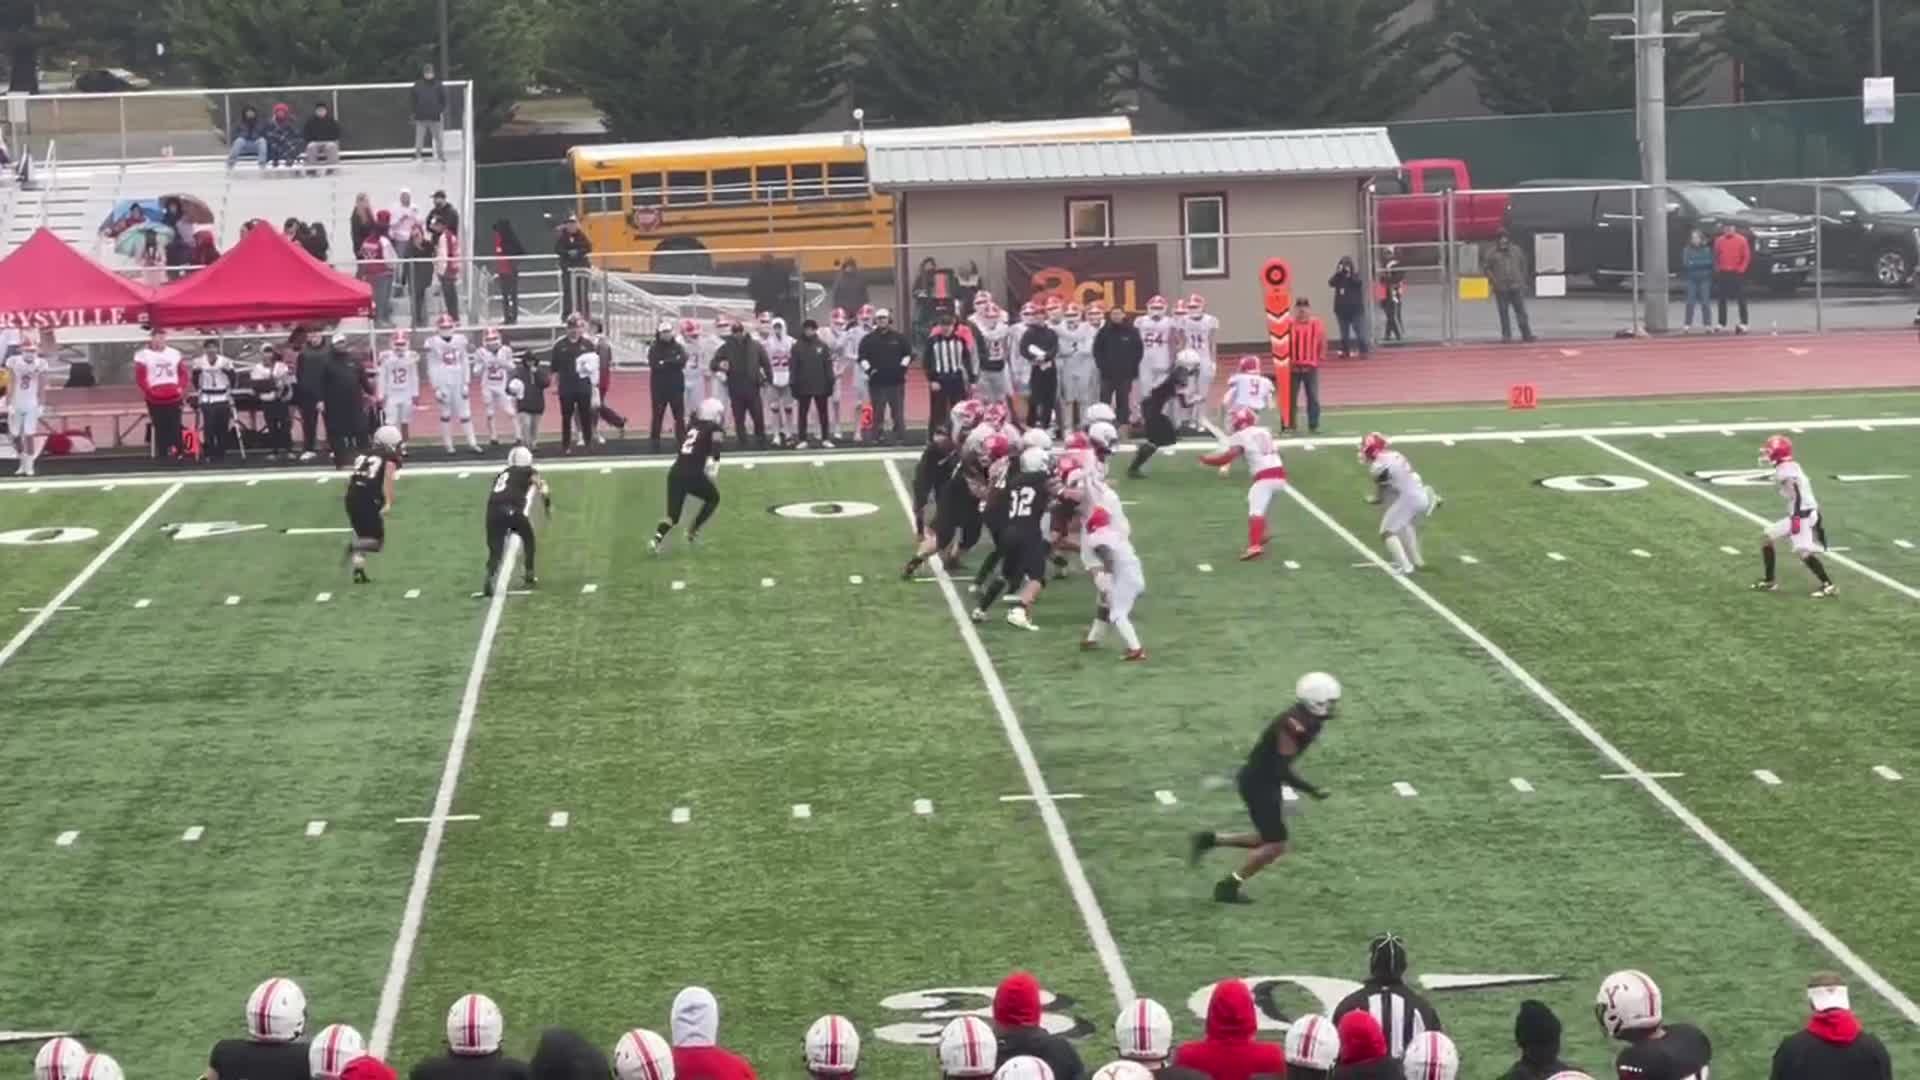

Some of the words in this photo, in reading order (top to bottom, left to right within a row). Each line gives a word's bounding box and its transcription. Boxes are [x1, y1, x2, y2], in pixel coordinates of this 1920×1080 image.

[392, 368, 408, 384] 12
[1511, 386, 1533, 404] 20
[681, 428, 700, 454] 2
